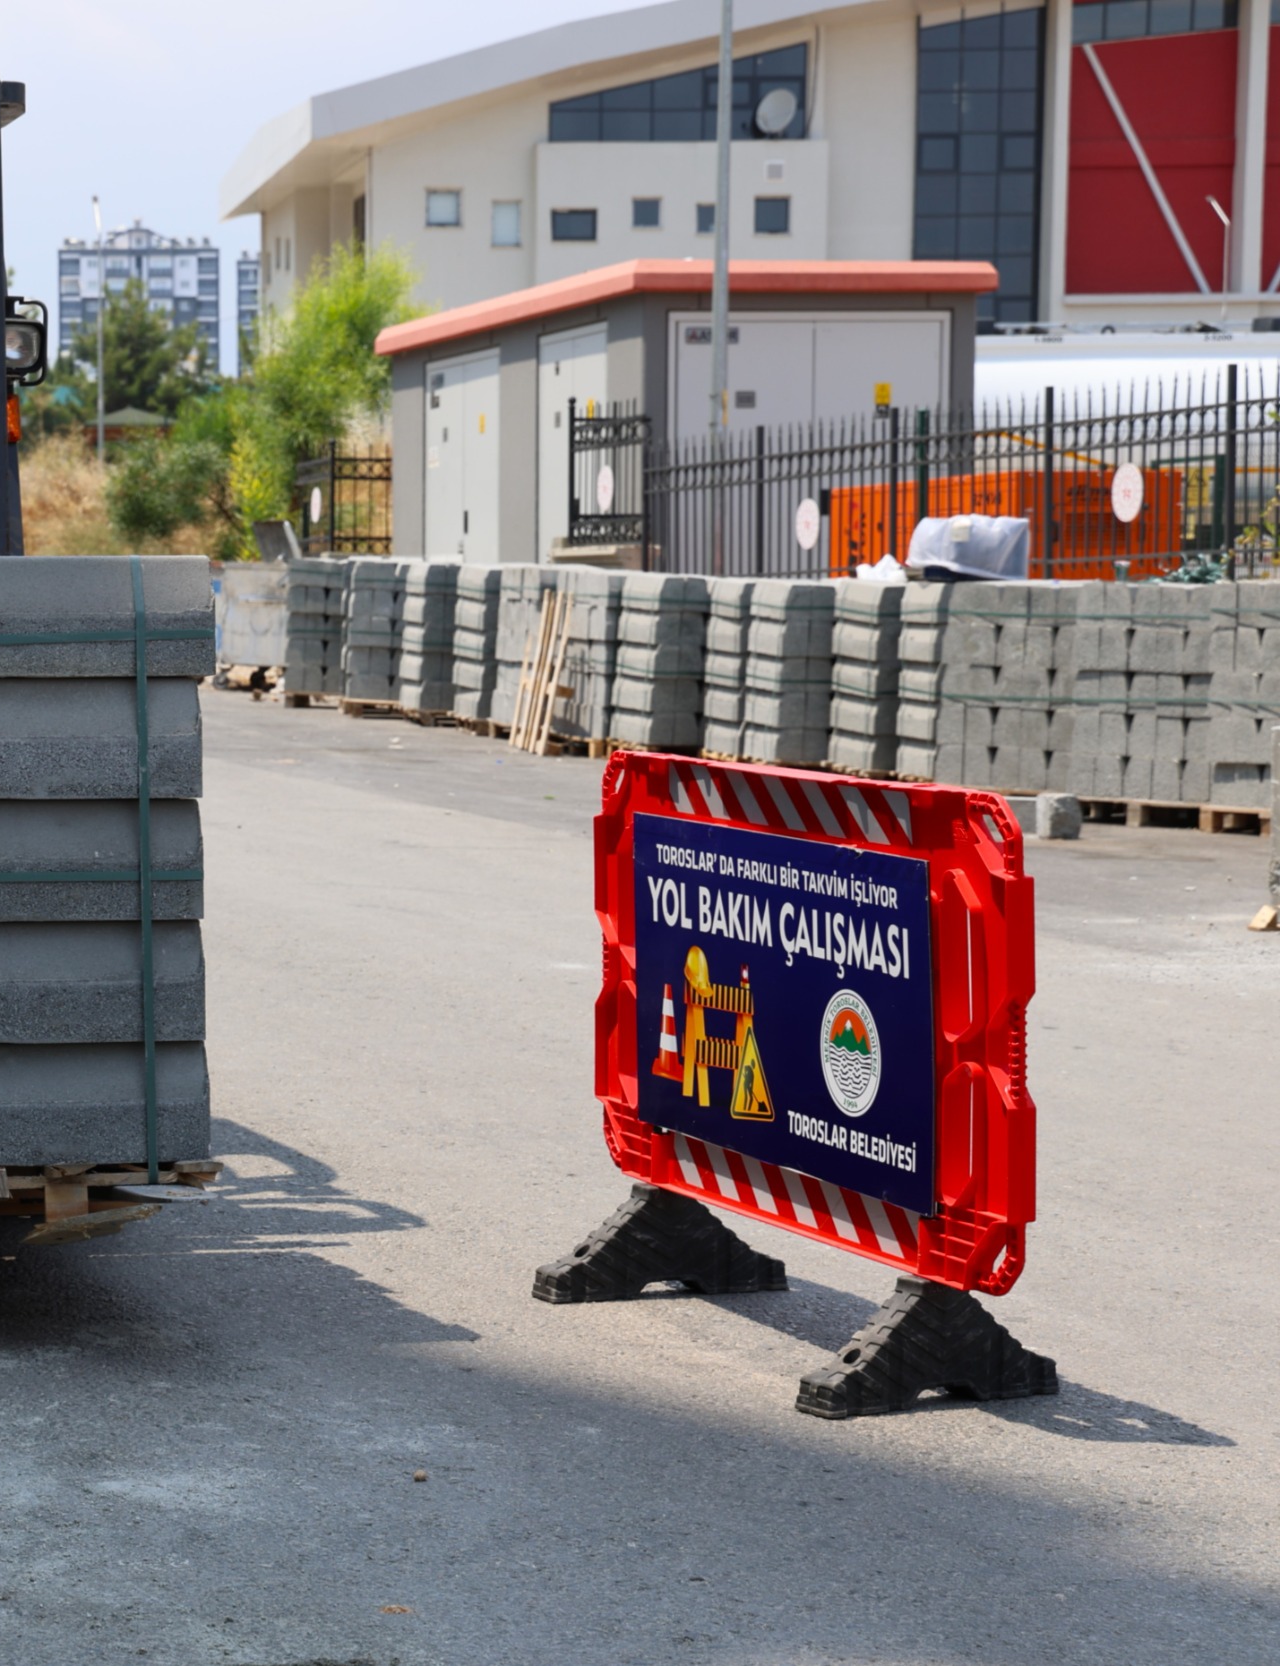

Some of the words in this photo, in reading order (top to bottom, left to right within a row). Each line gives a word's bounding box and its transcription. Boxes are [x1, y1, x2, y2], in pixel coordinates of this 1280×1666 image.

[655, 843, 717, 873] TOROSLAR'
[719, 855, 735, 878] DA
[737, 858, 777, 886] FARKLI
[780, 861, 800, 890] BİR
[802, 870, 848, 899] TAKVİM
[851, 873, 898, 910] İŞLİYOR
[647, 875, 693, 930] YOL
[698, 885, 773, 948] BAKIM
[779, 902, 910, 979] ÇALIŞMASI
[787, 1110, 848, 1151] TOROSLAR
[850, 1129, 916, 1173] BELEDİYESİ
